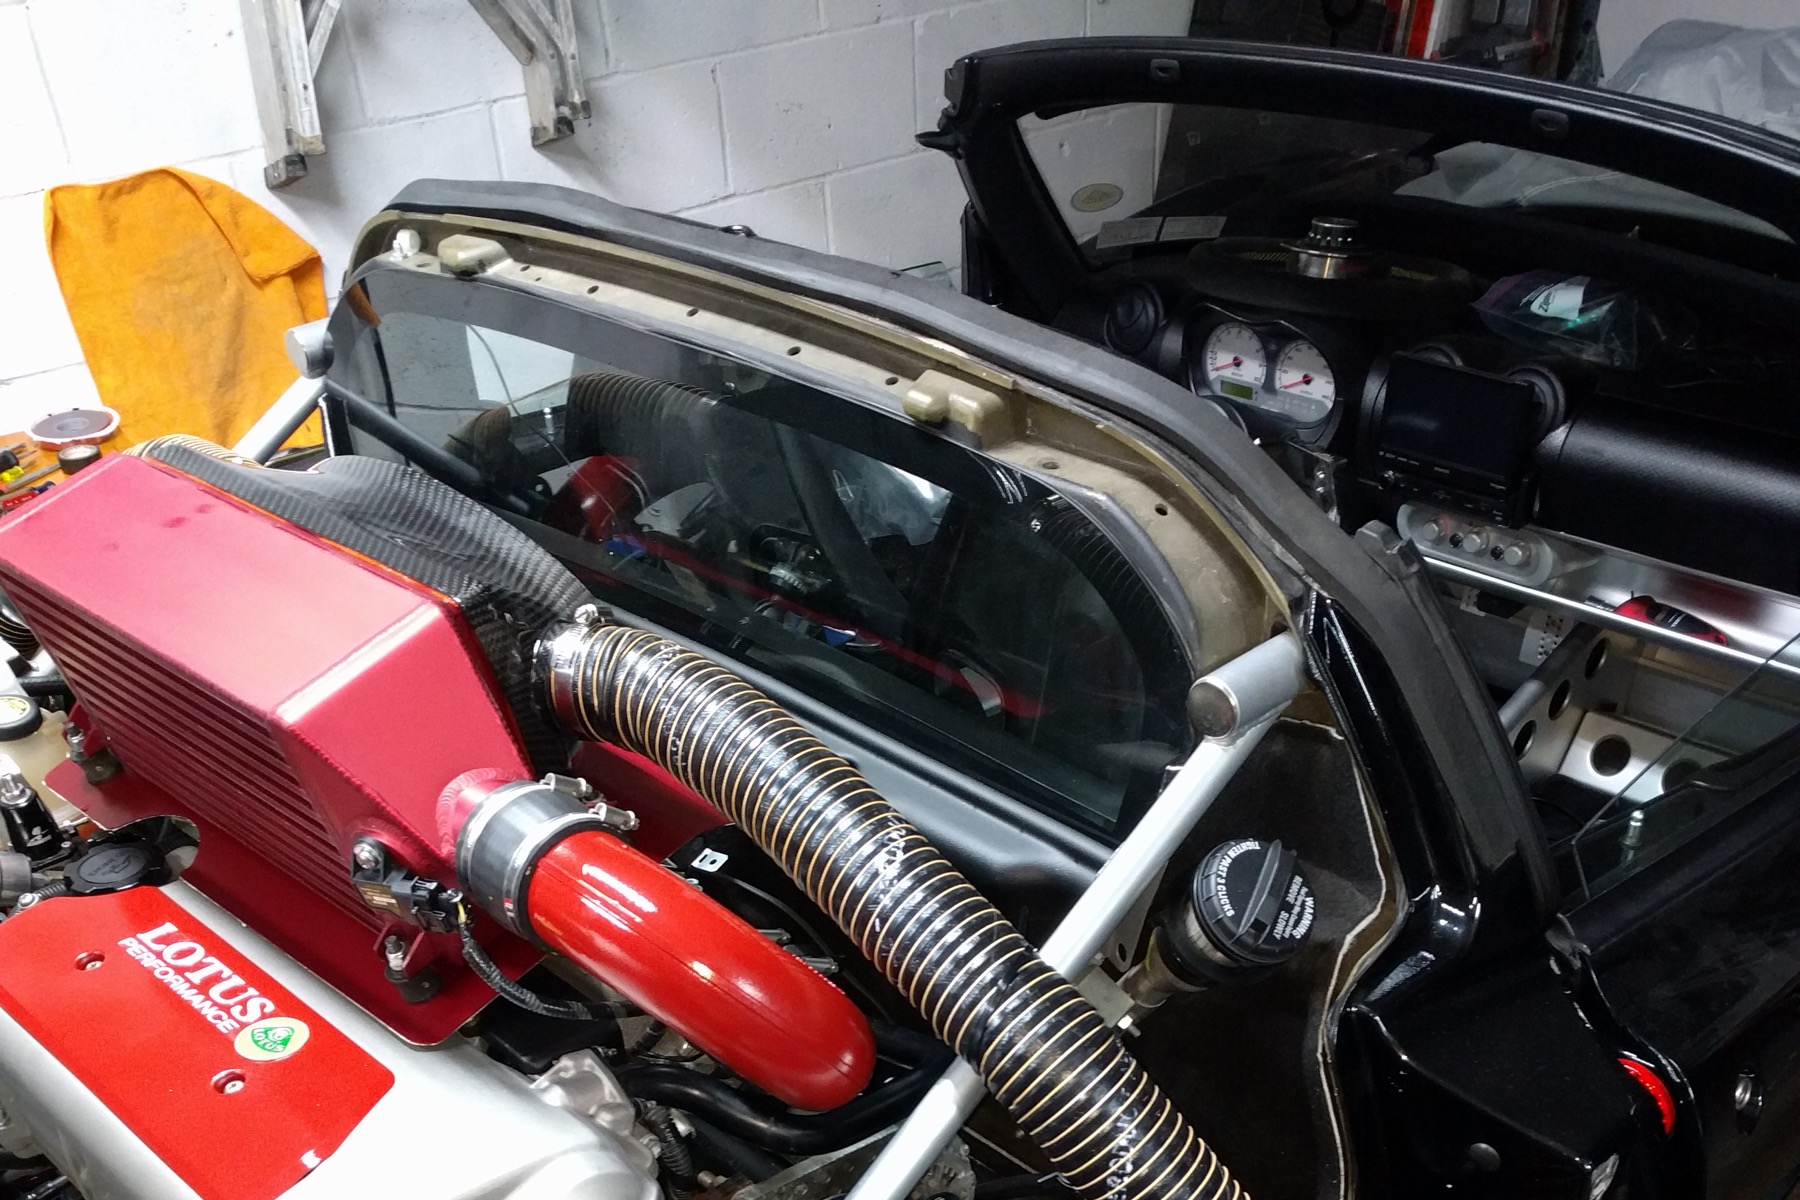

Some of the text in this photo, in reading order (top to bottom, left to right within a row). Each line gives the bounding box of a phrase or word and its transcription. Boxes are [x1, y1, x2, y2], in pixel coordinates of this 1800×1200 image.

[1217, 841, 1261, 917] TIGHTEN PAST 3 CLICKS
[1272, 875, 1303, 940] REMOVE SLOWLY
[1291, 897, 1315, 939] WARNING
[117, 937, 241, 1034] PERFORMANCE
[136, 921, 275, 1023] LOTUS
[252, 1028, 286, 1051] LOTUS
